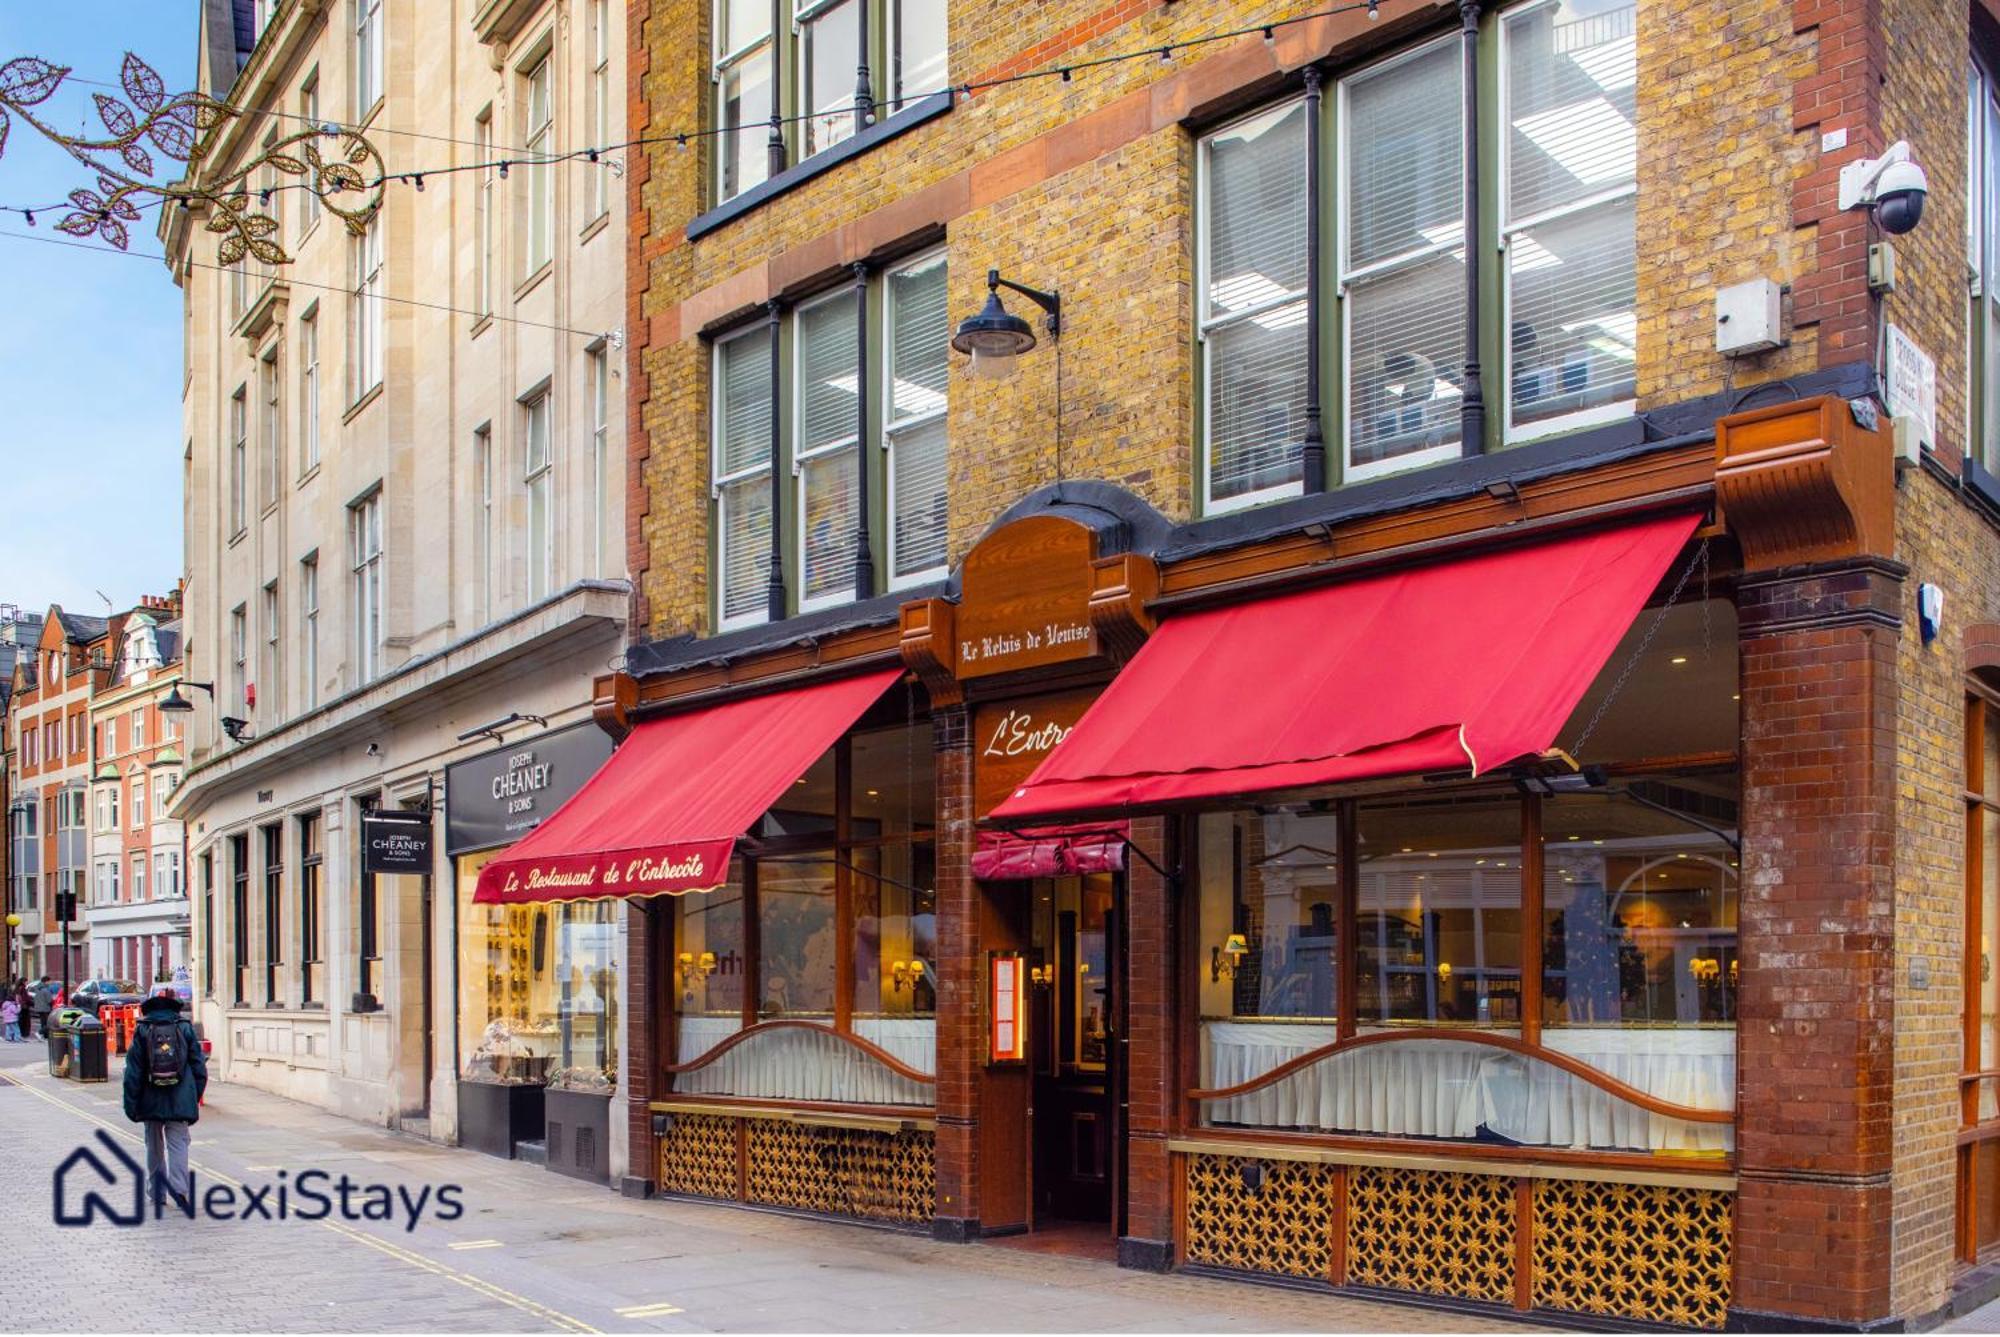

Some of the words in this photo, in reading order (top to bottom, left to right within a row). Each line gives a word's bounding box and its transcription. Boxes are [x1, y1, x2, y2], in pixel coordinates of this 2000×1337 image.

[962, 641, 978, 661] Le
[982, 634, 1021, 658] Relais
[1027, 631, 1040, 649] de
[1046, 623, 1090, 647] Venise
[509, 752, 533, 772] JOSEPH
[492, 763, 548, 799] CHEANEY
[514, 797, 532, 813] SONS
[372, 839, 426, 851] CHEANEY
[504, 872, 519, 893] Le
[524, 866, 596, 890] Restaurant
[603, 862, 620, 884] de
[625, 854, 704, 882] l'Entrecôte
